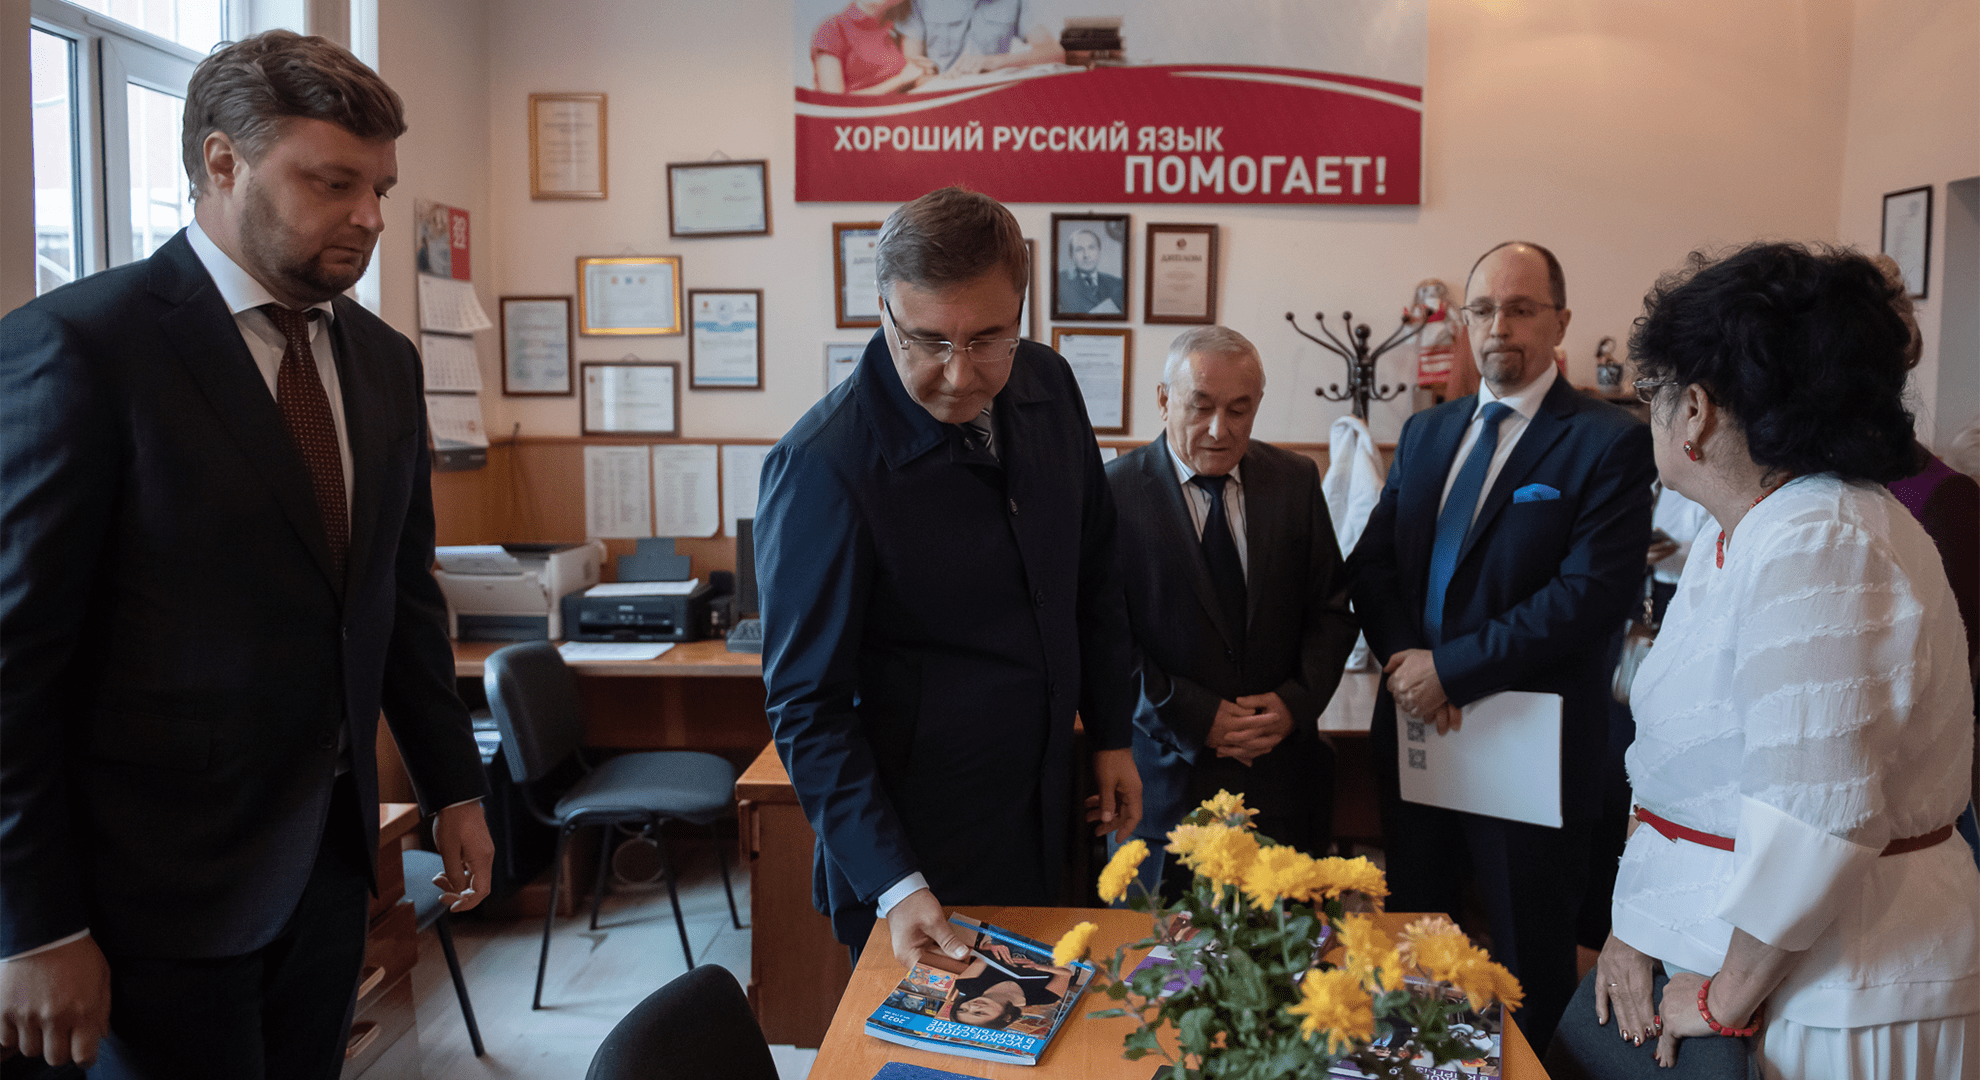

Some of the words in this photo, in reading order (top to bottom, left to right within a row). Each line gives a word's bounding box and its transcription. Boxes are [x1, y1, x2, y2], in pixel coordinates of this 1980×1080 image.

[834, 121, 983, 151] ХОРОШИЙ
[993, 121, 1129, 151] РУССКИЙ
[1137, 126, 1224, 151] ЯЗЫК
[1125, 156, 1386, 194] ПОМОГАЕТ!
[925, 1025, 970, 1037] СЛОВО
[932, 1019, 1025, 1042] КЫРГЫЗСТАНЕ
[971, 1033, 1034, 1050] РУССКОЕ
[1027, 1038, 1036, 1046] В
